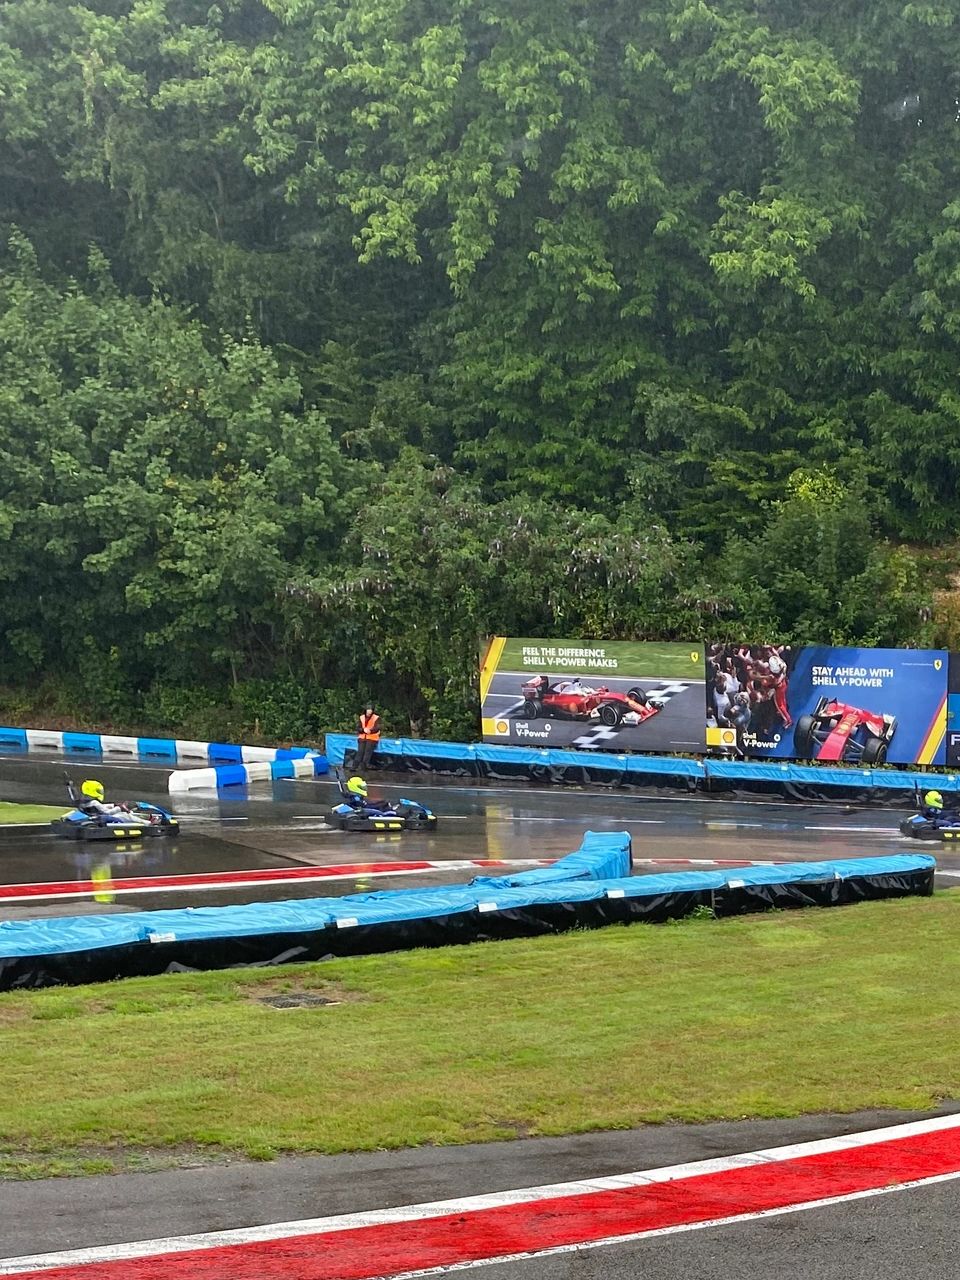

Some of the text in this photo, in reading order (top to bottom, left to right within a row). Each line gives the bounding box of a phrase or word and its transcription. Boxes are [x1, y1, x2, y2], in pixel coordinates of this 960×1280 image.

[522, 647, 606, 658] FEEL THE DIFFERENCE
[523, 657, 618, 668] SHELL V-POWER MAKES
[812, 666, 894, 678] STAY AHEAD WITH
[812, 677, 883, 687] SHELL V-POWER
[516, 729, 549, 738] V-Power
[743, 739, 778, 748] V-Power
